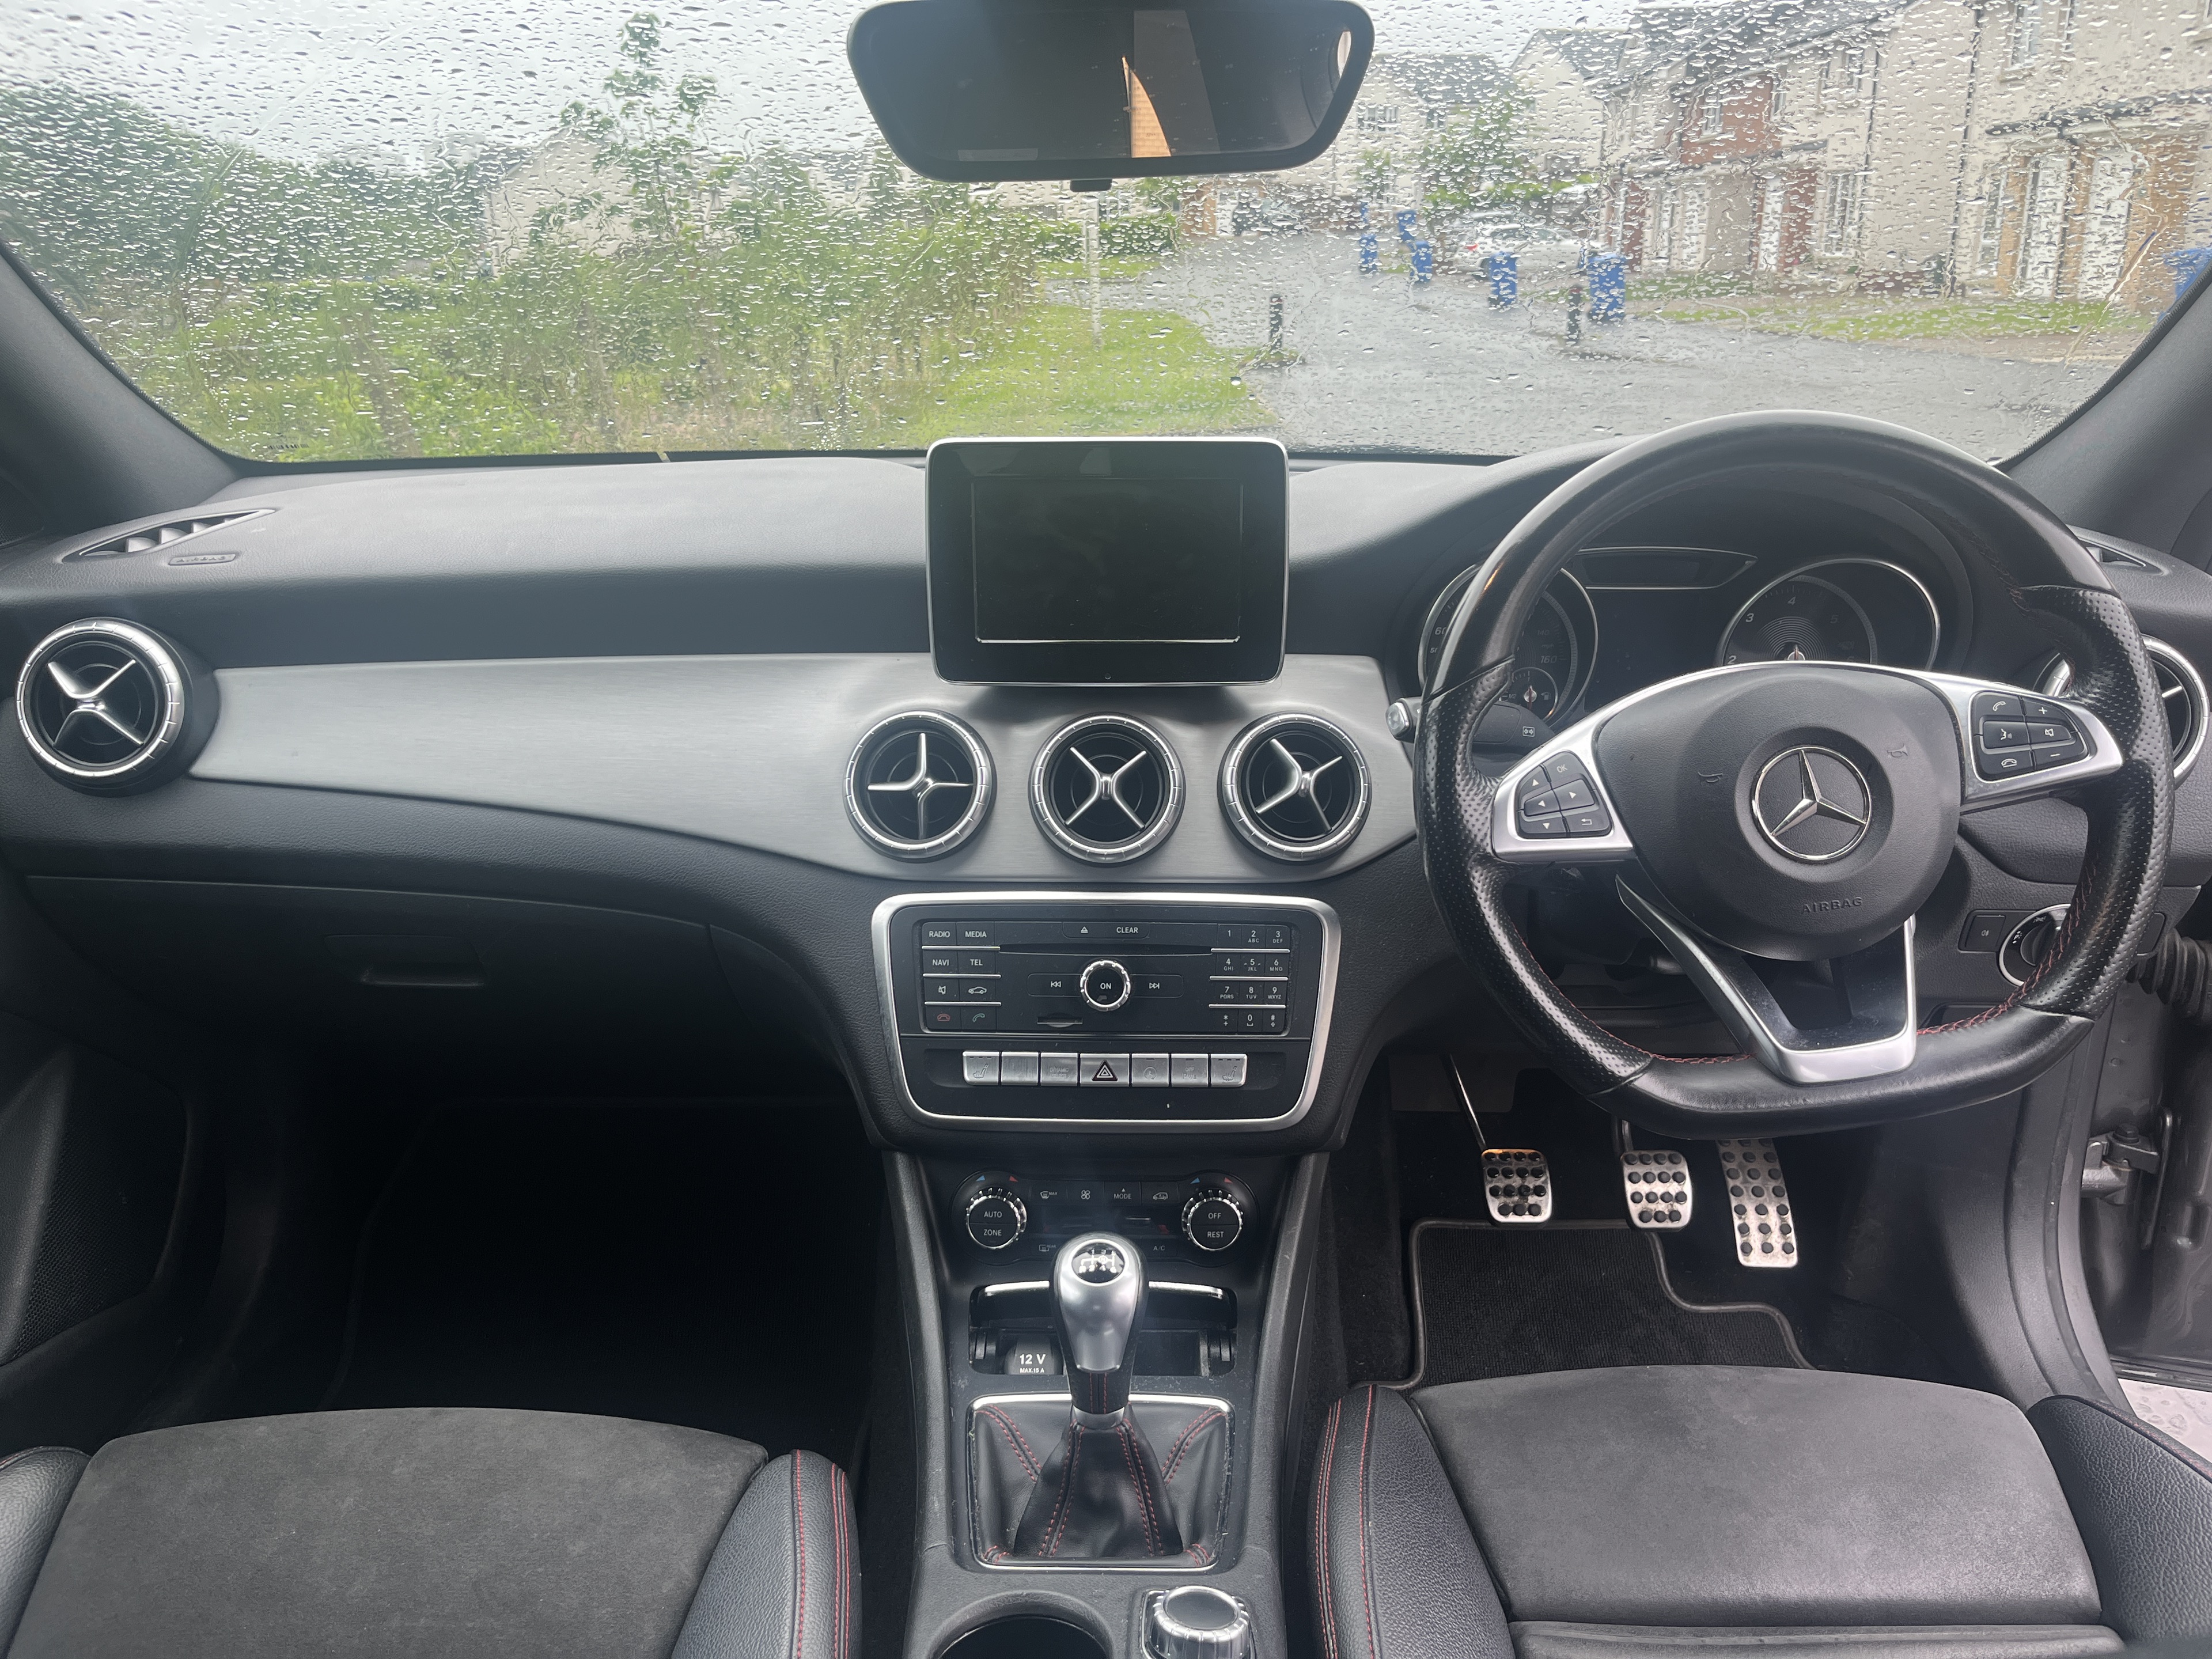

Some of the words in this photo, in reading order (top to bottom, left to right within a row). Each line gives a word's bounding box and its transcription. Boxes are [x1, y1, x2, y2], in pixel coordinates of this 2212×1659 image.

[1787, 596, 1796, 605] 4
[1746, 613, 1754, 622] 3
[1540, 656, 1558, 664] 160
[1728, 656, 1737, 664] 2
[1556, 764, 1567, 773] OK
[1802, 897, 1863, 914] AIRBAG
[1019, 1354, 1033, 1365] 12
[1036, 1354, 1046, 1365] V
